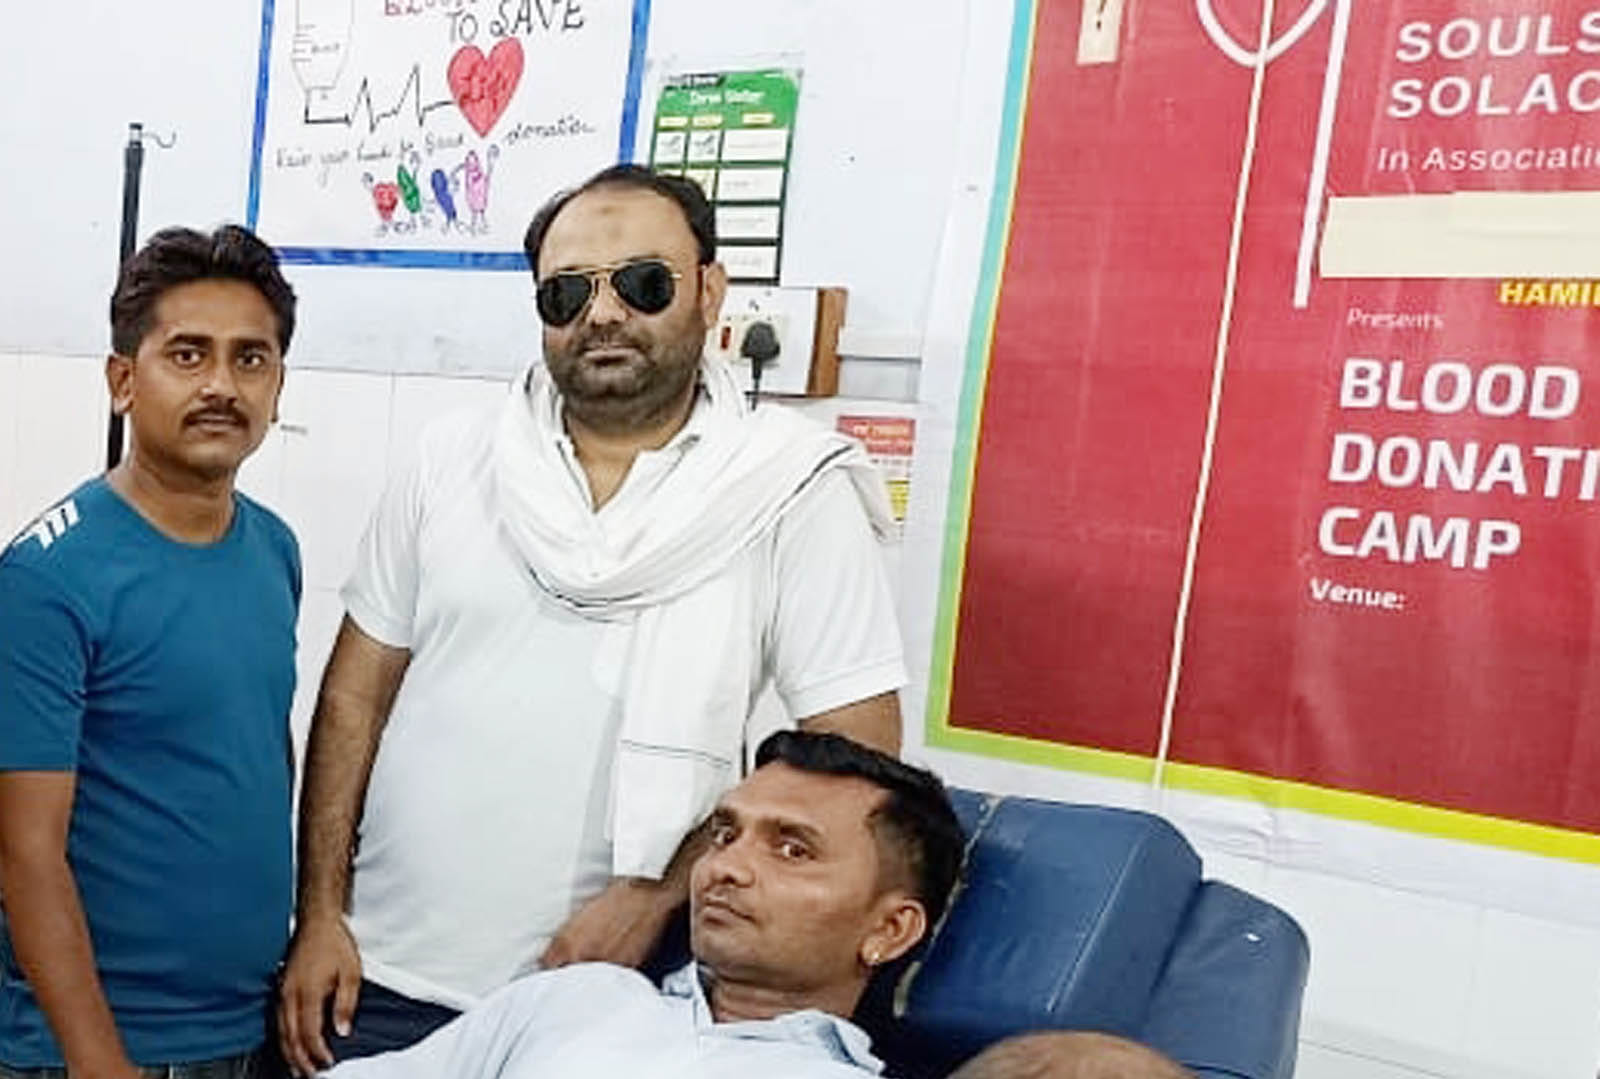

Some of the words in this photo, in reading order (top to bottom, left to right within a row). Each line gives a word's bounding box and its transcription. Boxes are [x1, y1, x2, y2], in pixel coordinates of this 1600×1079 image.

[444, 10, 479, 43] TO
[489, 0, 585, 37] SAVE
[1395, 11, 1600, 63] SOULS
[1377, 147, 1410, 171] In
[1421, 143, 1600, 171] Associati
[1500, 281, 1600, 307] HAMI
[1347, 306, 1445, 331] Presents
[1338, 357, 1581, 419] BLOOD
[1326, 432, 1600, 501] DONATI
[1317, 506, 1522, 570] CAMP
[1309, 576, 1406, 610] Venue:
